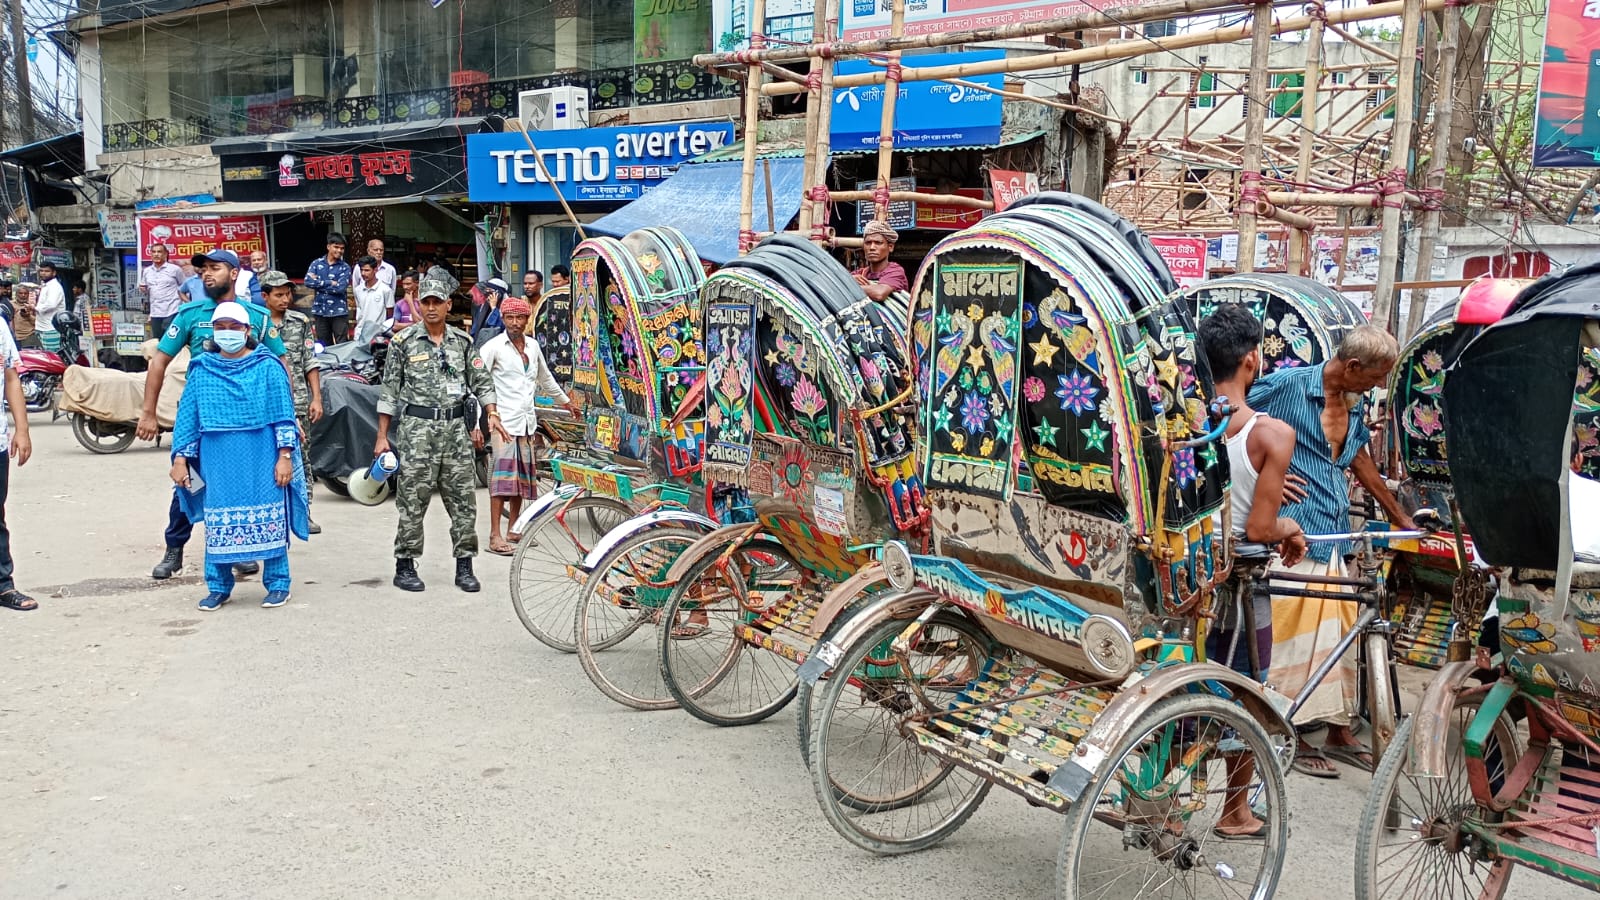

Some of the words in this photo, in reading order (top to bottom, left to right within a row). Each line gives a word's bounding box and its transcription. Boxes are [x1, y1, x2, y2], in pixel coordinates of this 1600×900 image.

[930, 84, 951, 94] দেশের
[303, 154, 354, 183] নাহার
[490, 147, 610, 184] TECNO
[173, 222, 217, 239] নাহার
[1177, 244, 1196, 255] টাইম
